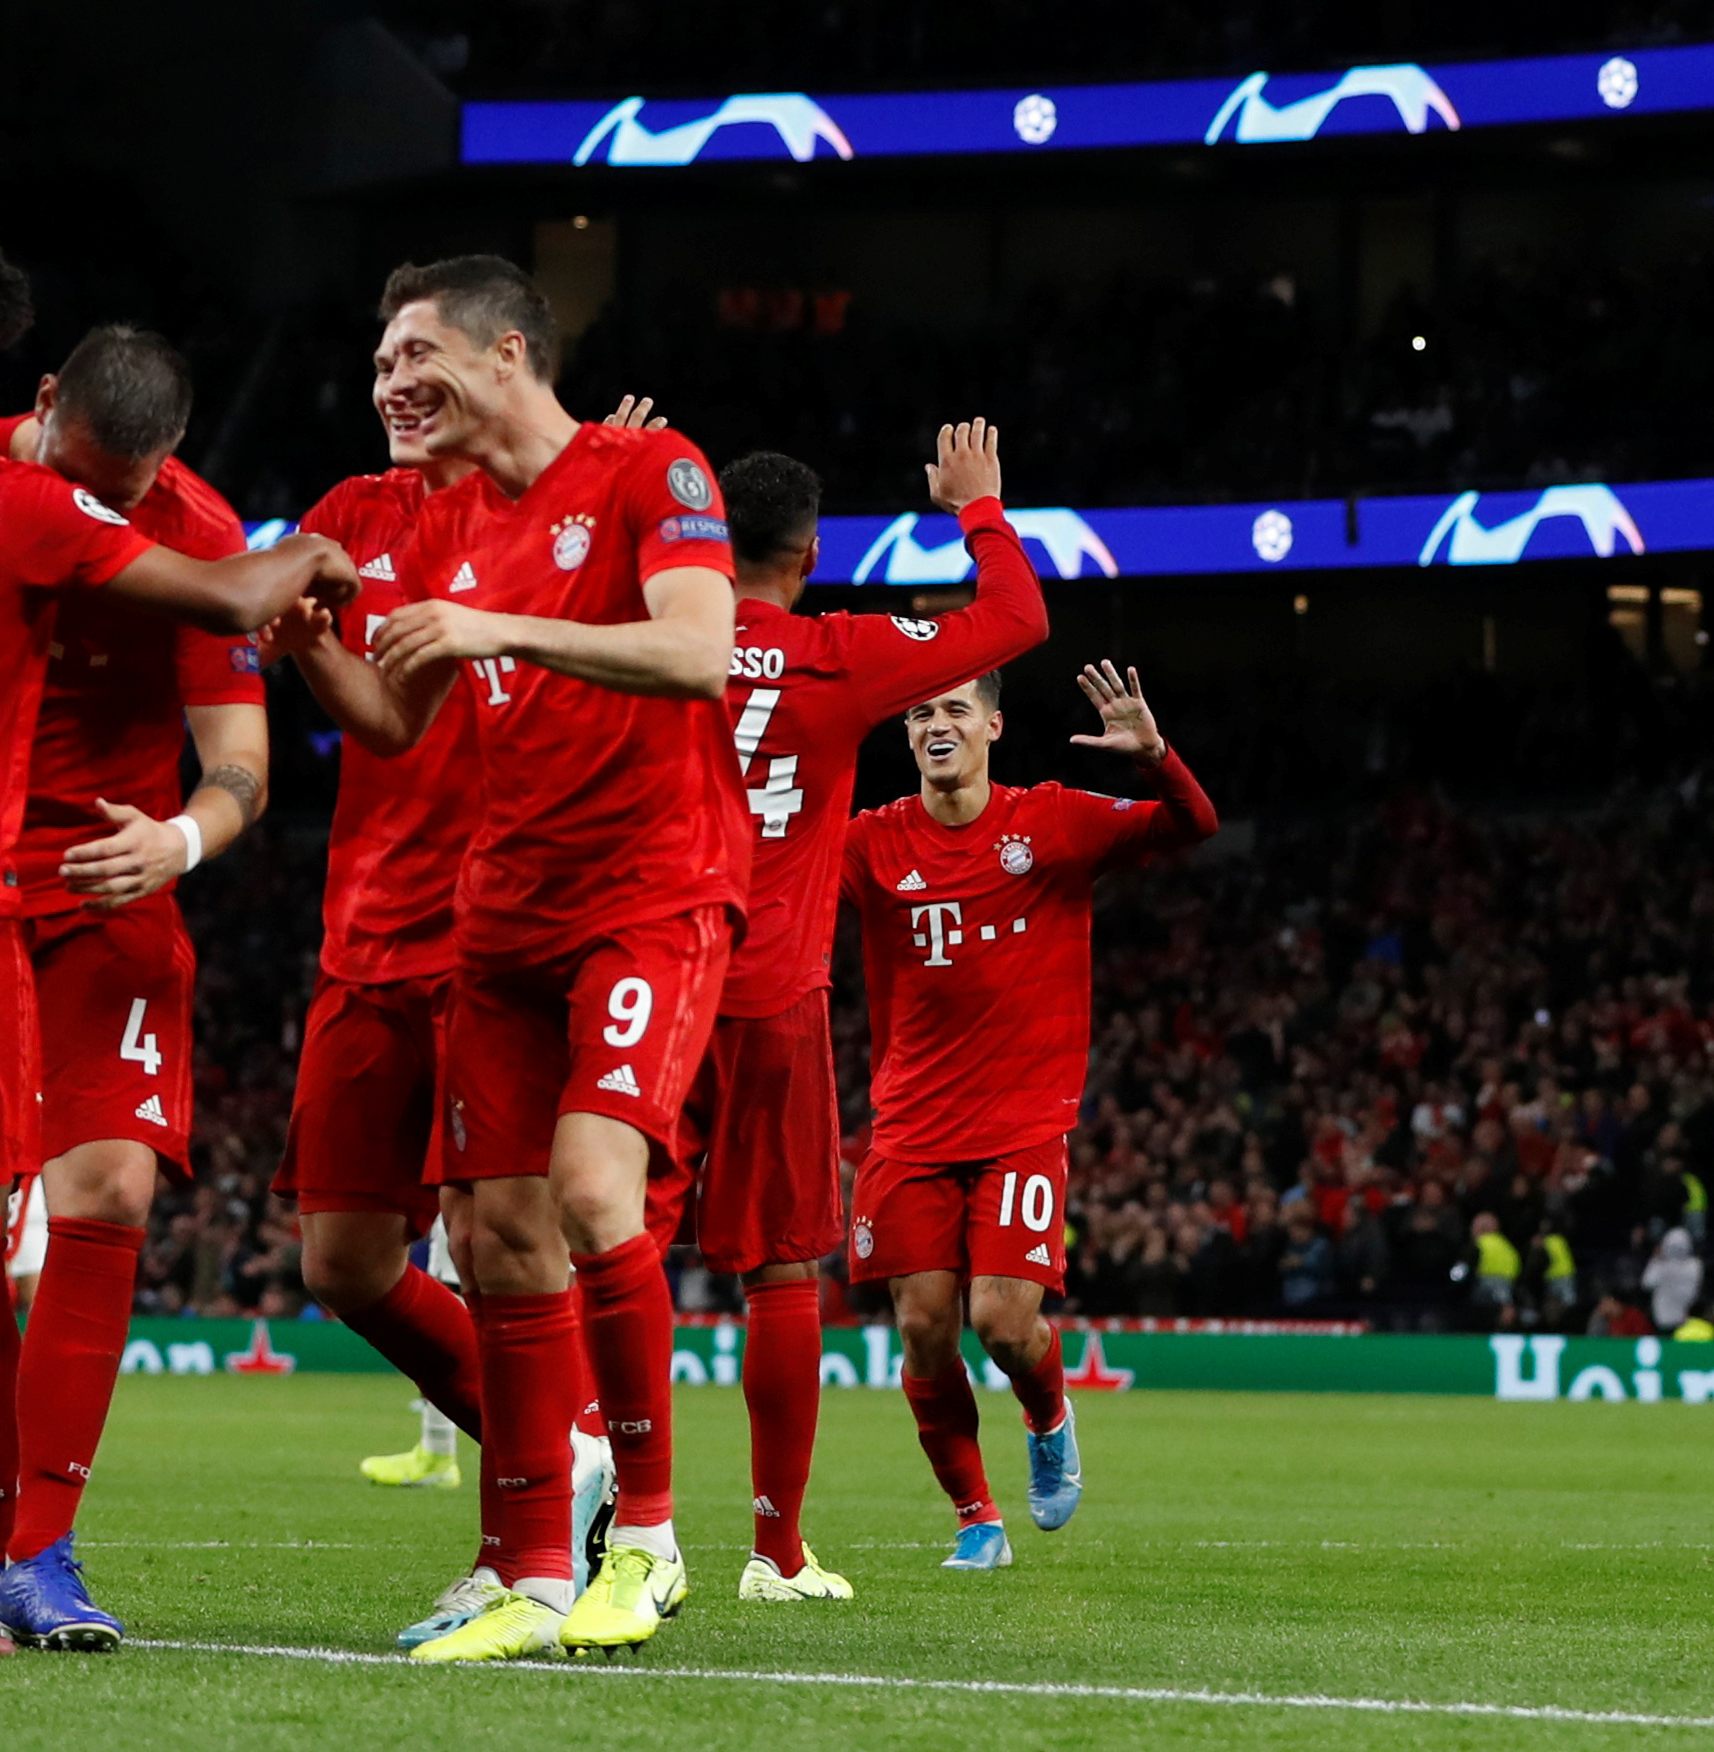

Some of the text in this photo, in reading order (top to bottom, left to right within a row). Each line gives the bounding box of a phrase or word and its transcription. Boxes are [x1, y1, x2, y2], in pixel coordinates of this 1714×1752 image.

[358, 567, 396, 582] adidas
[734, 689, 803, 837] 4
[896, 881, 927, 890] adidas
[602, 976, 653, 1048] 9
[120, 998, 162, 1075] 4
[597, 1079, 640, 1097] adidas
[999, 1172, 1053, 1232] 10
[608, 1419, 652, 1434] FCB
[68, 1461, 91, 1480] FC
